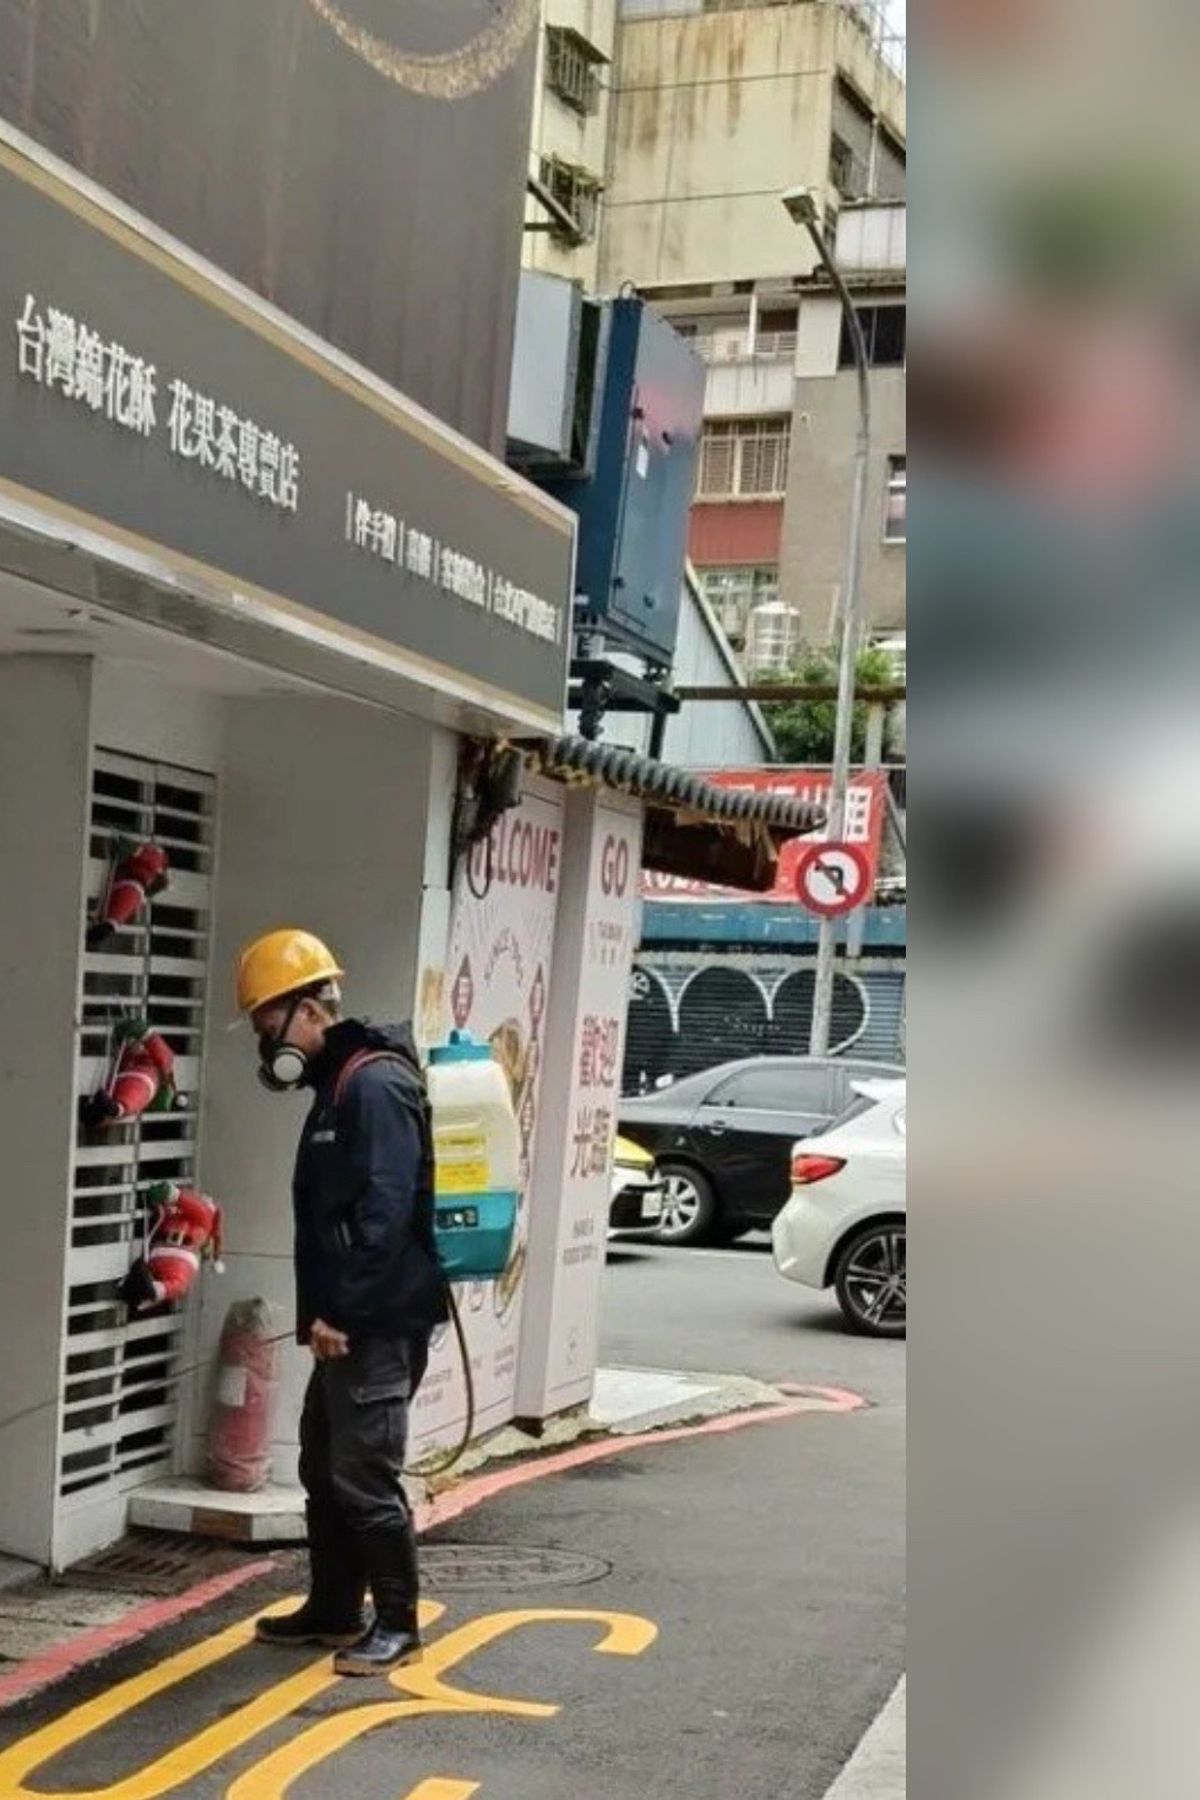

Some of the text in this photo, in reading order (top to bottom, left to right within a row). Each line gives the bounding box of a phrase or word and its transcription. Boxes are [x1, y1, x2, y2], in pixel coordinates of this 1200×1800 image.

[167, 379, 299, 513] 花果茶專賣店
[601, 834, 629, 897] GO
